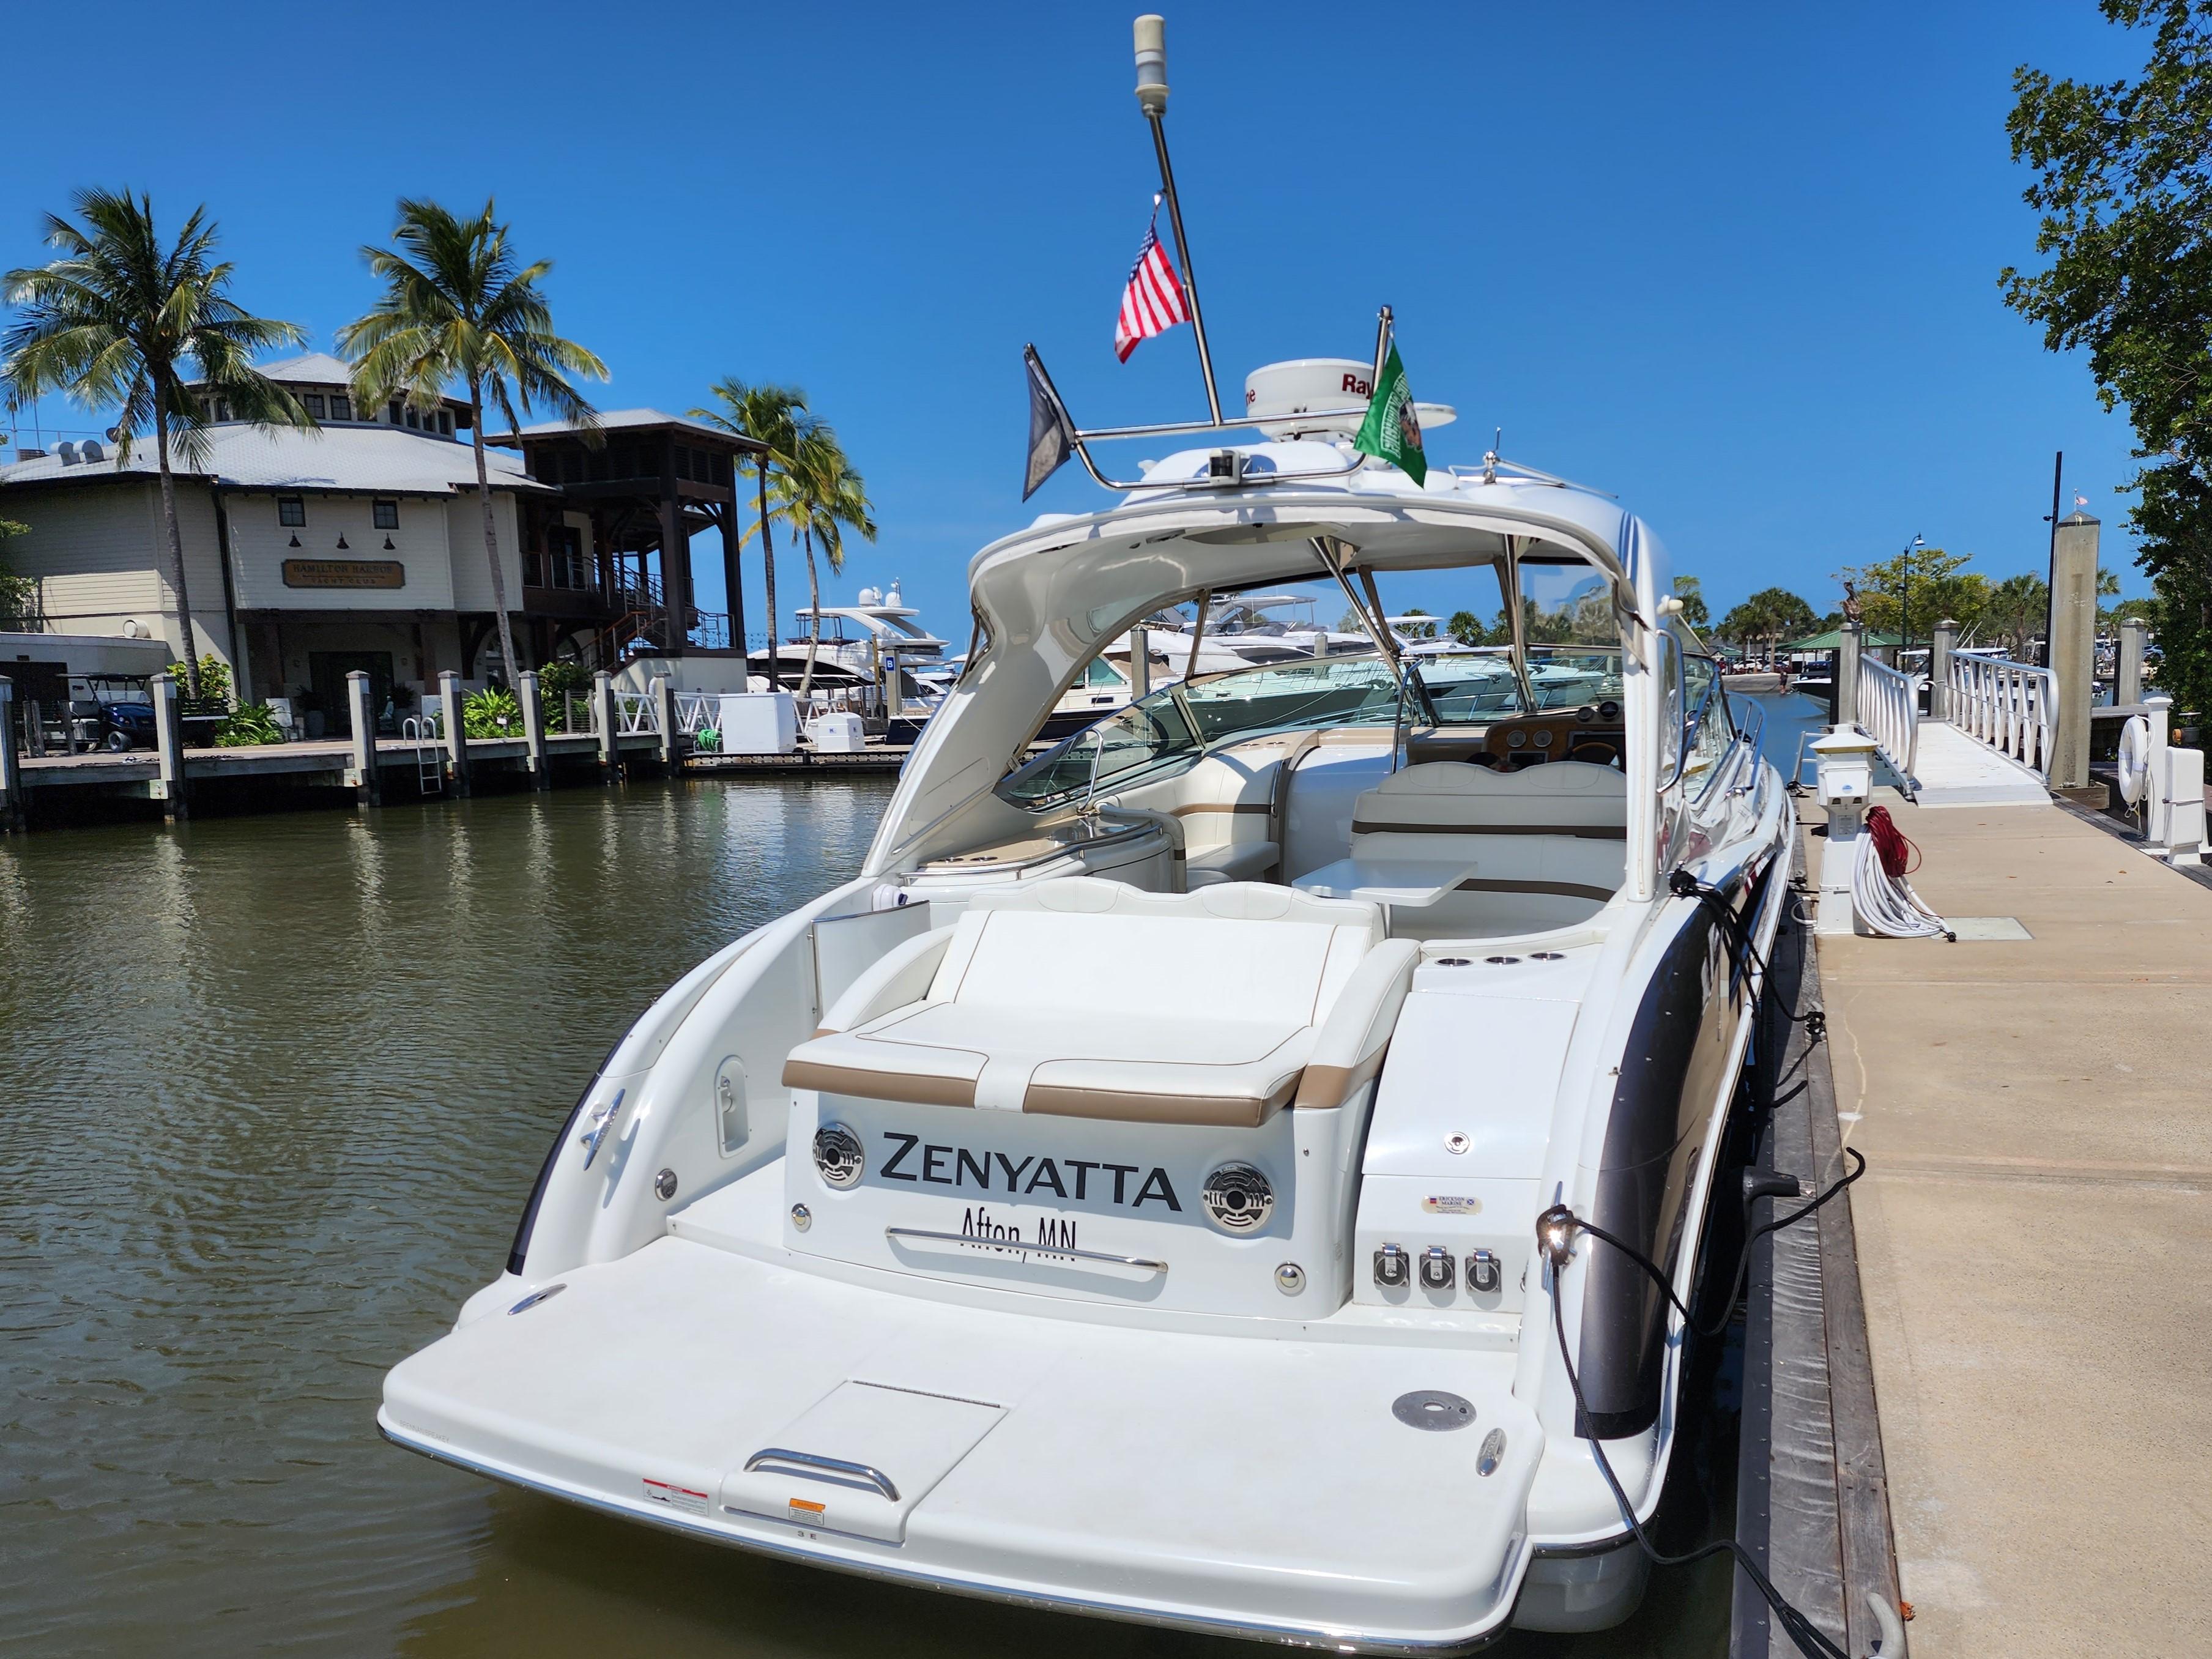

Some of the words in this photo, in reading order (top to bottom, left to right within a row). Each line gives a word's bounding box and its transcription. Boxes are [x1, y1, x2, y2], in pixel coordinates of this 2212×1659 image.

[880, 1132, 1182, 1212] ZENYATTA
[960, 1206, 1027, 1264] Afton,
[1037, 1217, 1077, 1262] MN
